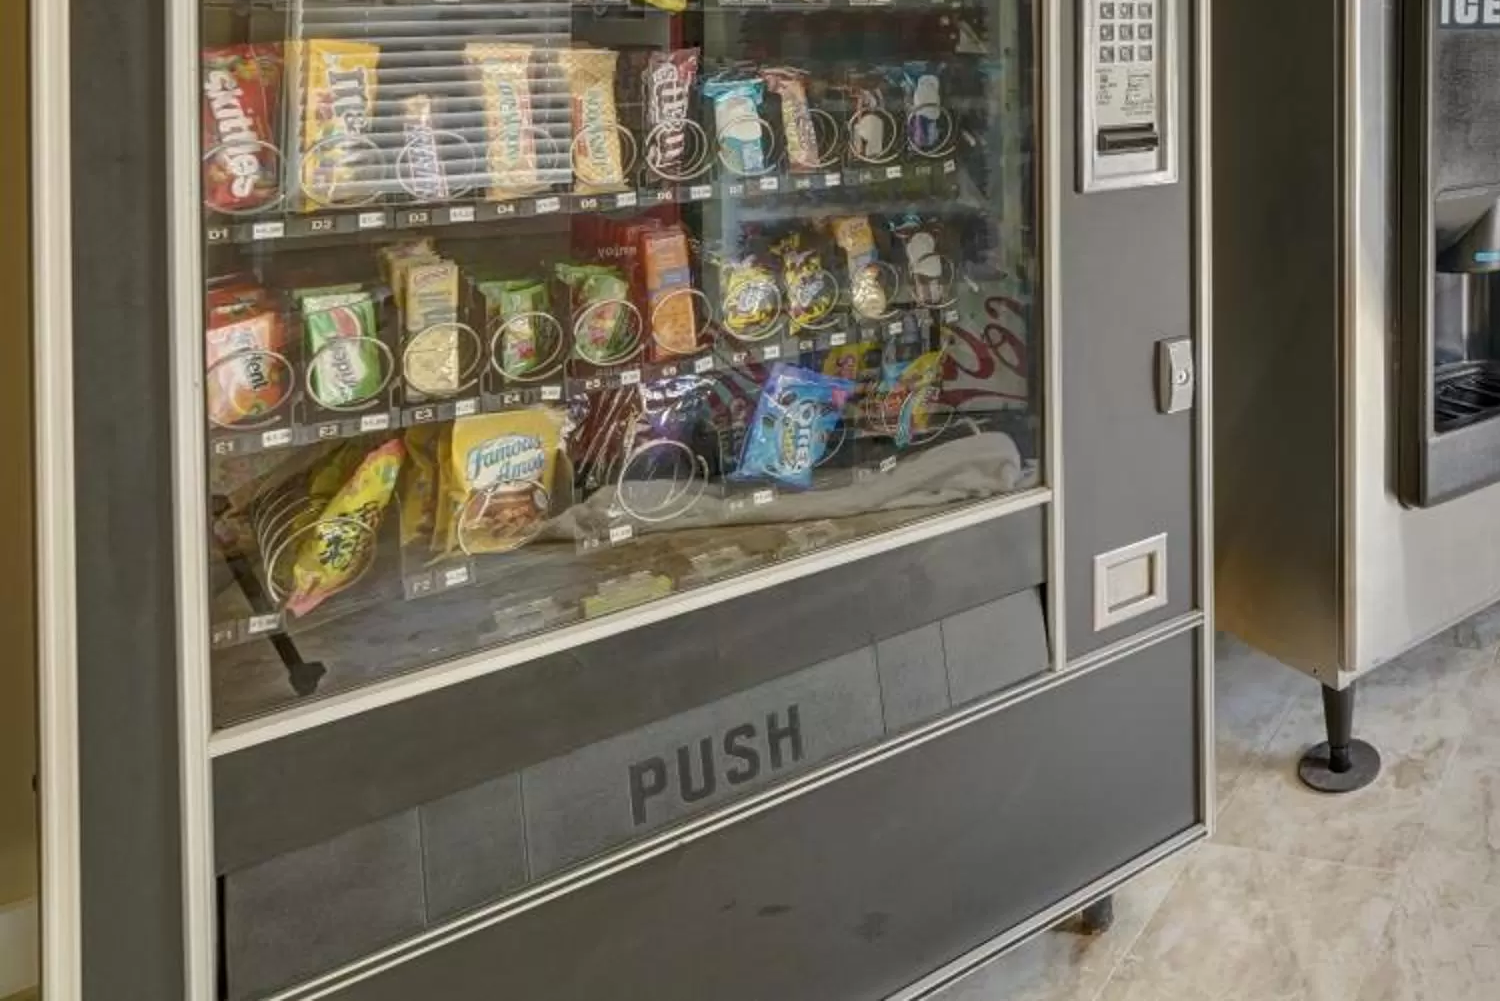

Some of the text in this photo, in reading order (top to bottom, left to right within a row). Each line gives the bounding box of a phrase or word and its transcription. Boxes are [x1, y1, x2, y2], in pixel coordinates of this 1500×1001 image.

[467, 432, 545, 480] Famous
[495, 454, 546, 479] Amos
[628, 704, 804, 826] PUSH
